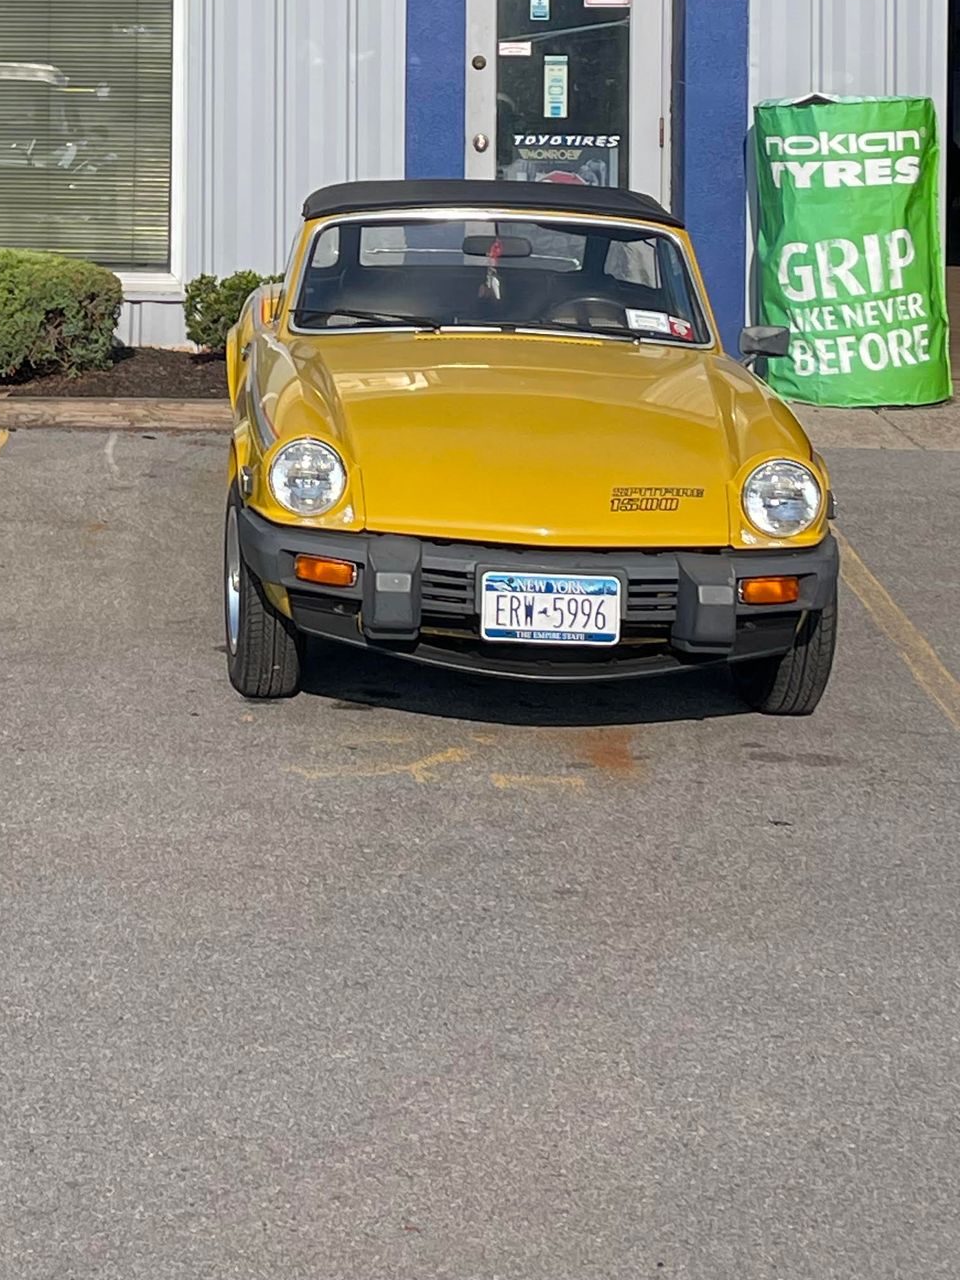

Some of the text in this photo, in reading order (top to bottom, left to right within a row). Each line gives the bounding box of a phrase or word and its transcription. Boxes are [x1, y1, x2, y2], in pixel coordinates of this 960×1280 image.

[770, 156, 921, 188] TYRES
[777, 228, 915, 302] GRIP
[840, 292, 928, 328] NEVER
[792, 323, 931, 377] BEFORE
[610, 498, 679, 512] 1500
[515, 577, 588, 595] NEW YORK
